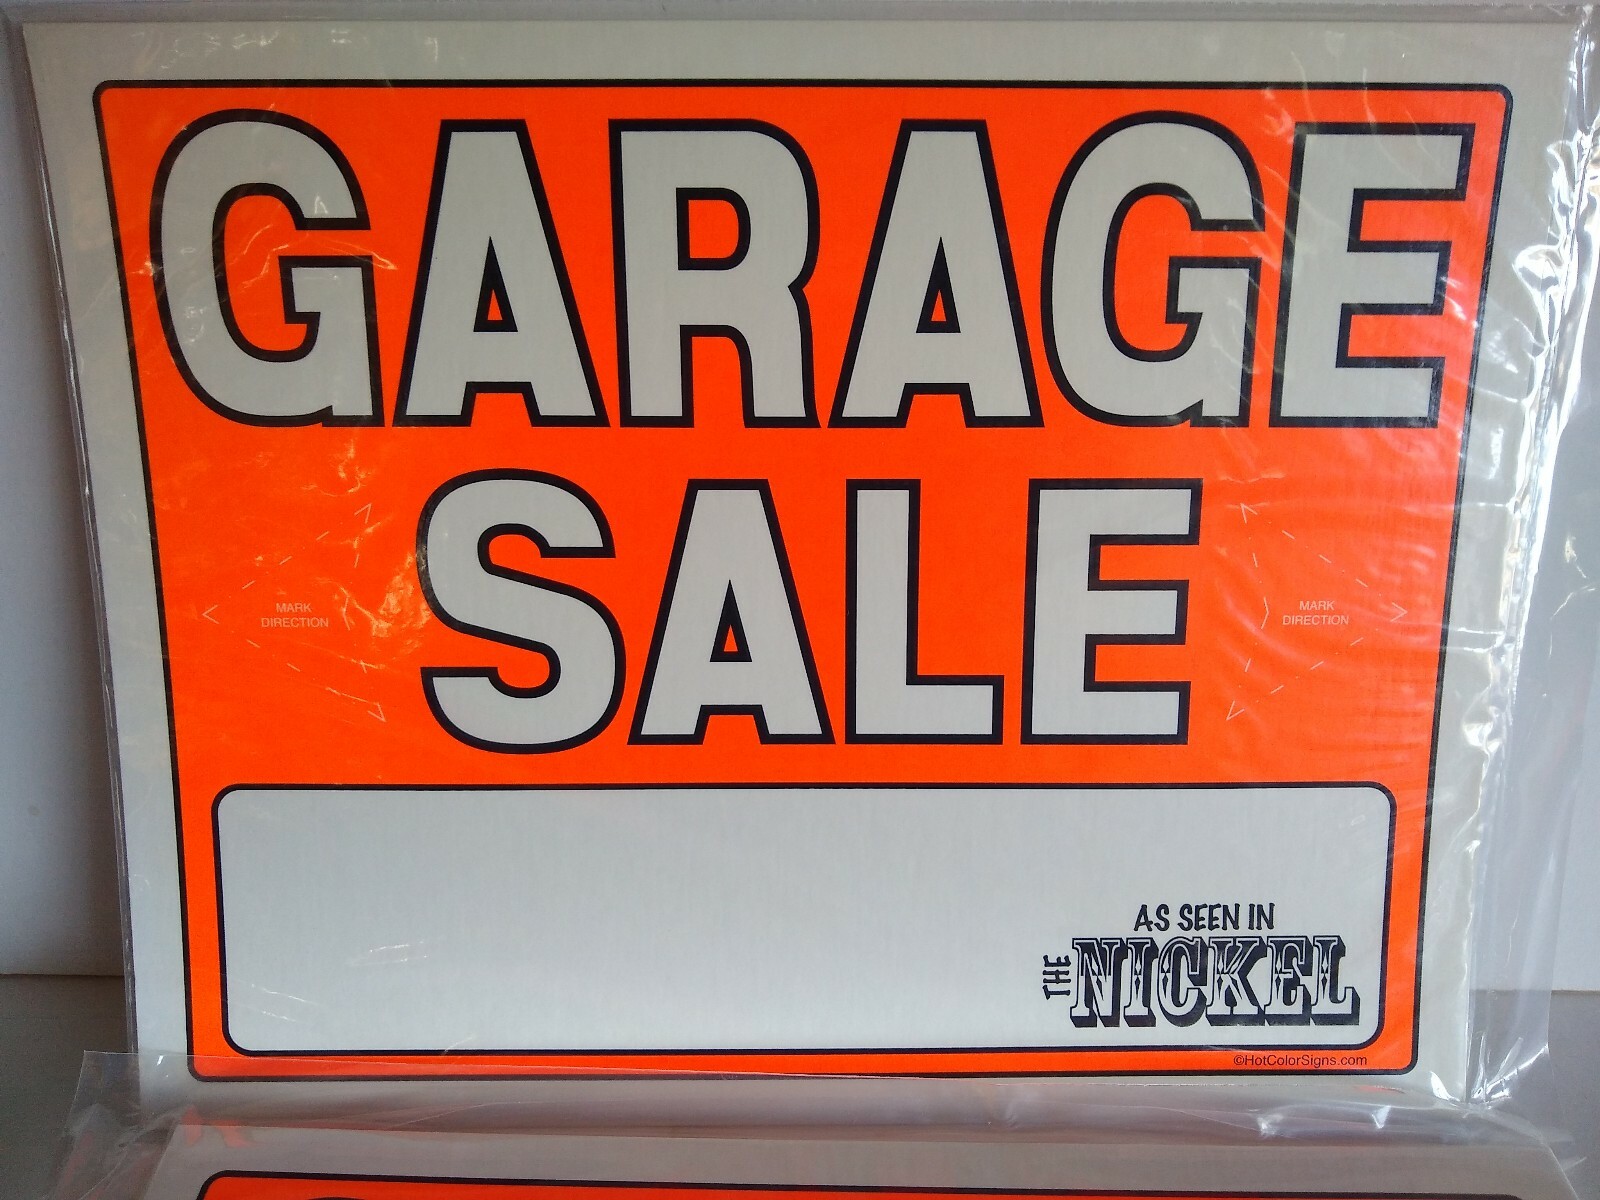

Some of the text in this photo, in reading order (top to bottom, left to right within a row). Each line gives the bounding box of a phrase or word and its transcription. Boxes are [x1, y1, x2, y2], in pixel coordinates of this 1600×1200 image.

[150, 109, 1475, 428] GARAGE
[275, 602, 312, 613] MARK
[417, 469, 1204, 754] SALE
[1299, 600, 1335, 611] MARK
[261, 617, 329, 628] DIRECTION
[1282, 614, 1349, 626] DIRECTION
[1134, 902, 1275, 932] AS SEEN IN
[1042, 935, 1361, 1028] THE NICKEL
[1233, 1054, 1368, 1069] ©HotColorSigns.com
